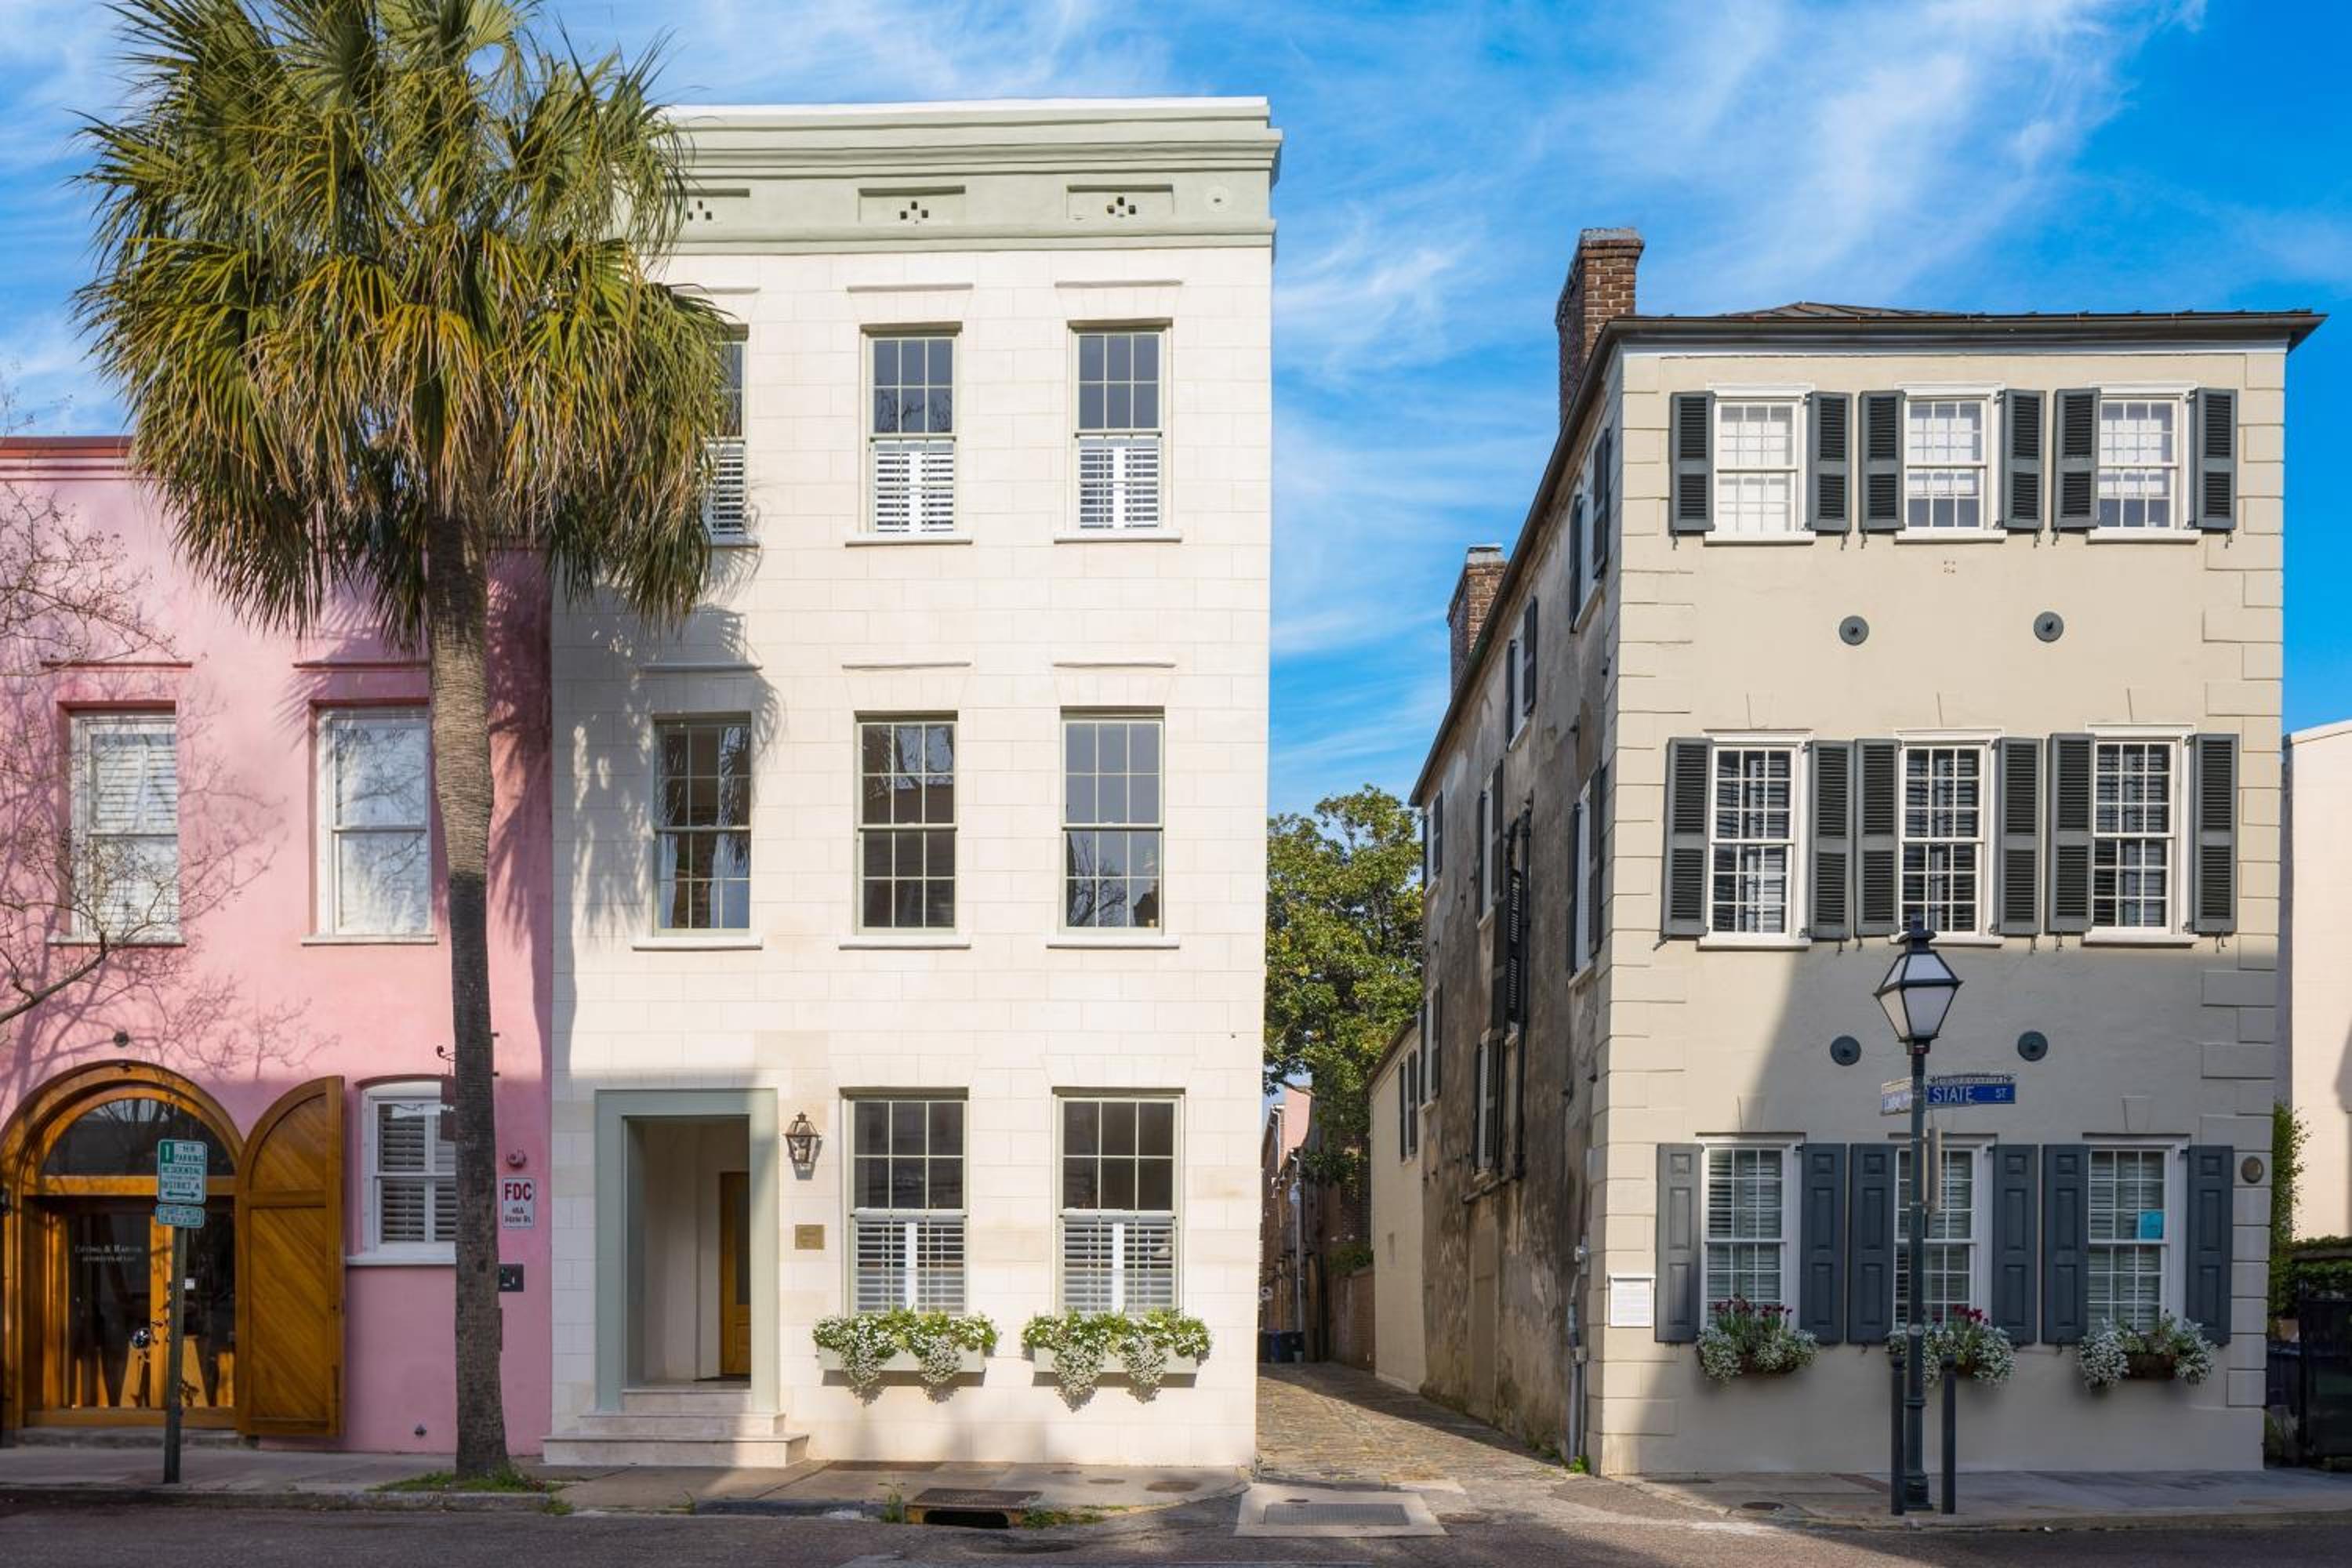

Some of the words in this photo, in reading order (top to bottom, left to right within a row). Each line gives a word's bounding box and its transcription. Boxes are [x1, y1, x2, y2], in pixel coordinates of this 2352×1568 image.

[1932, 1085, 1975, 1102] STATE
[1994, 1087, 2008, 1099] ST
[176, 1153, 205, 1162] PARKING
[505, 1183, 532, 1201] FDC
